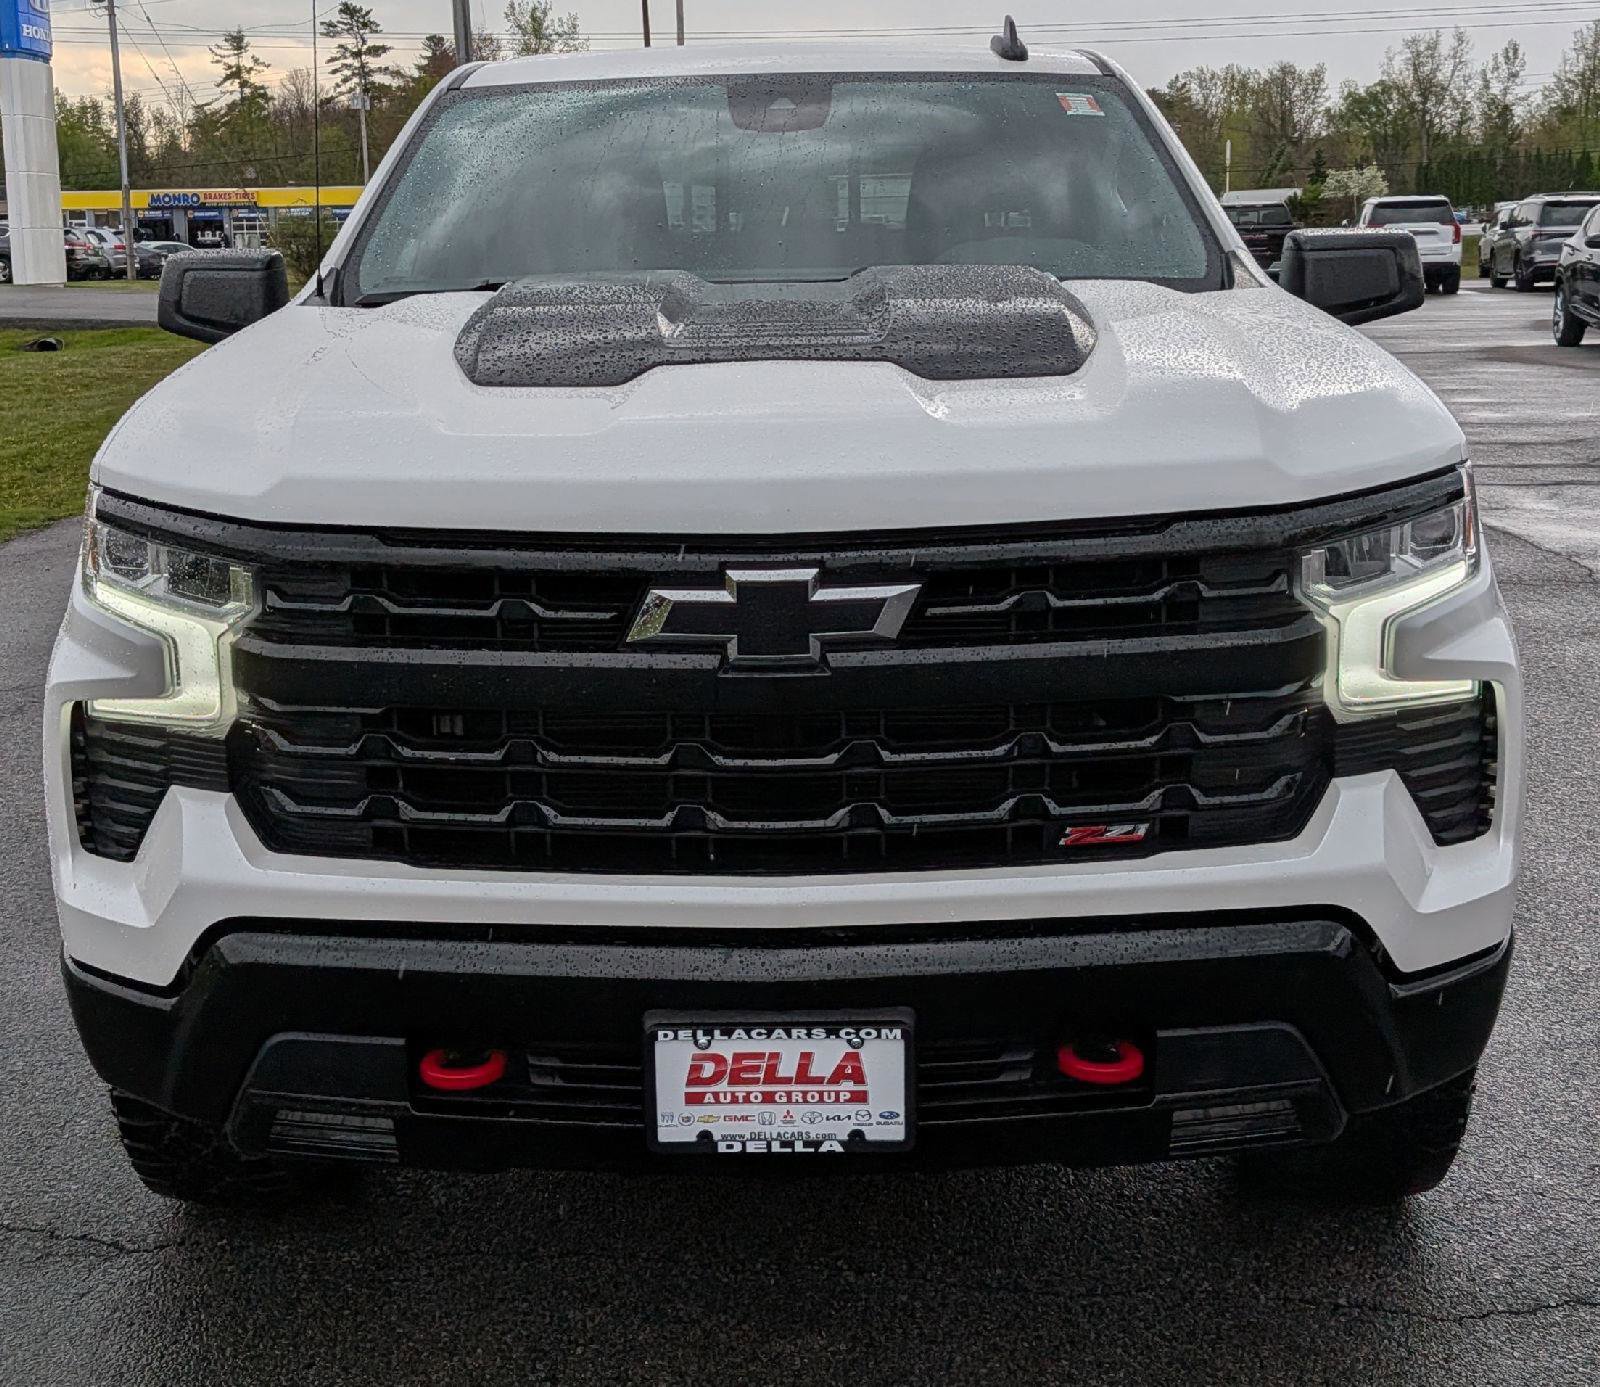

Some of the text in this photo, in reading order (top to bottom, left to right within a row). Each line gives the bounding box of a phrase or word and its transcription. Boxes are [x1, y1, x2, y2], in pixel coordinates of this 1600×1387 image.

[150, 192, 201, 206] MONRO
[1059, 823, 1150, 846] Z71
[657, 1028, 902, 1042] DELLACARS.COM
[686, 1051, 868, 1087] DELLA
[703, 1090, 852, 1103] AUTO GROUP
[723, 1114, 756, 1122] GMC
[720, 1131, 837, 1140] www.DELLACARS.com
[717, 1140, 845, 1153] DELLA
